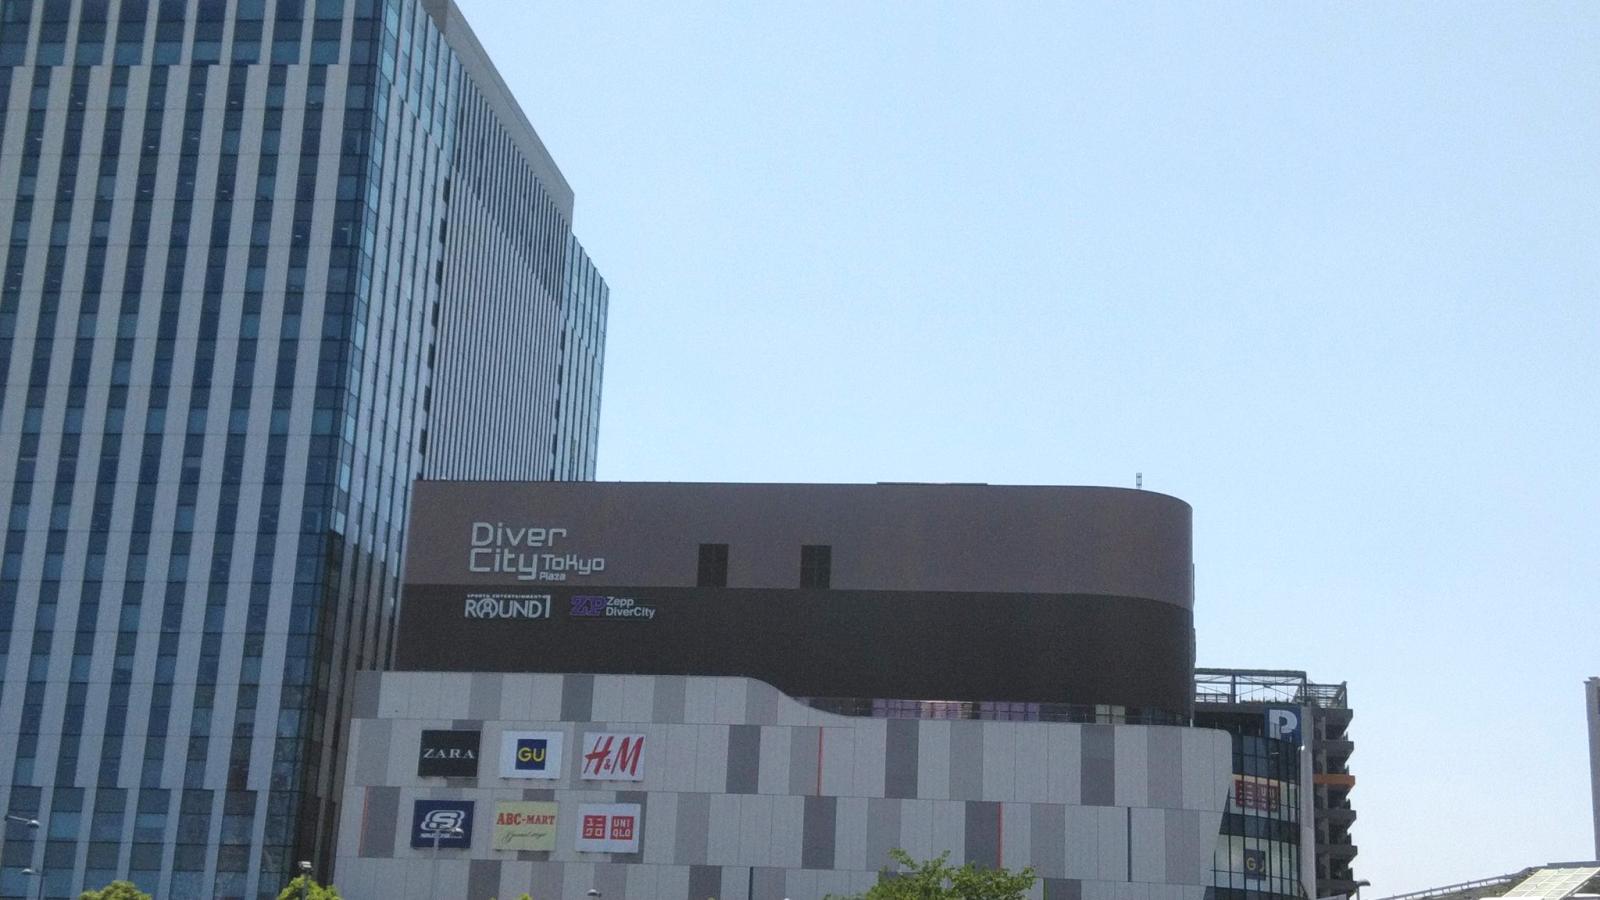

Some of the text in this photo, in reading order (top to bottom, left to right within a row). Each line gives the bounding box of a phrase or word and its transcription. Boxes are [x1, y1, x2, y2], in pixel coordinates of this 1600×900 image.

[471, 522, 567, 547] Diver
[469, 548, 538, 580] City
[539, 572, 566, 581] Plaza
[606, 596, 634, 607] Zepp
[606, 607, 656, 619] DiverCity
[1269, 709, 1297, 739] P
[423, 748, 475, 759] ZARA
[517, 746, 546, 762] GU
[583, 736, 645, 776] H&M
[496, 813, 556, 825] ABC-MART
